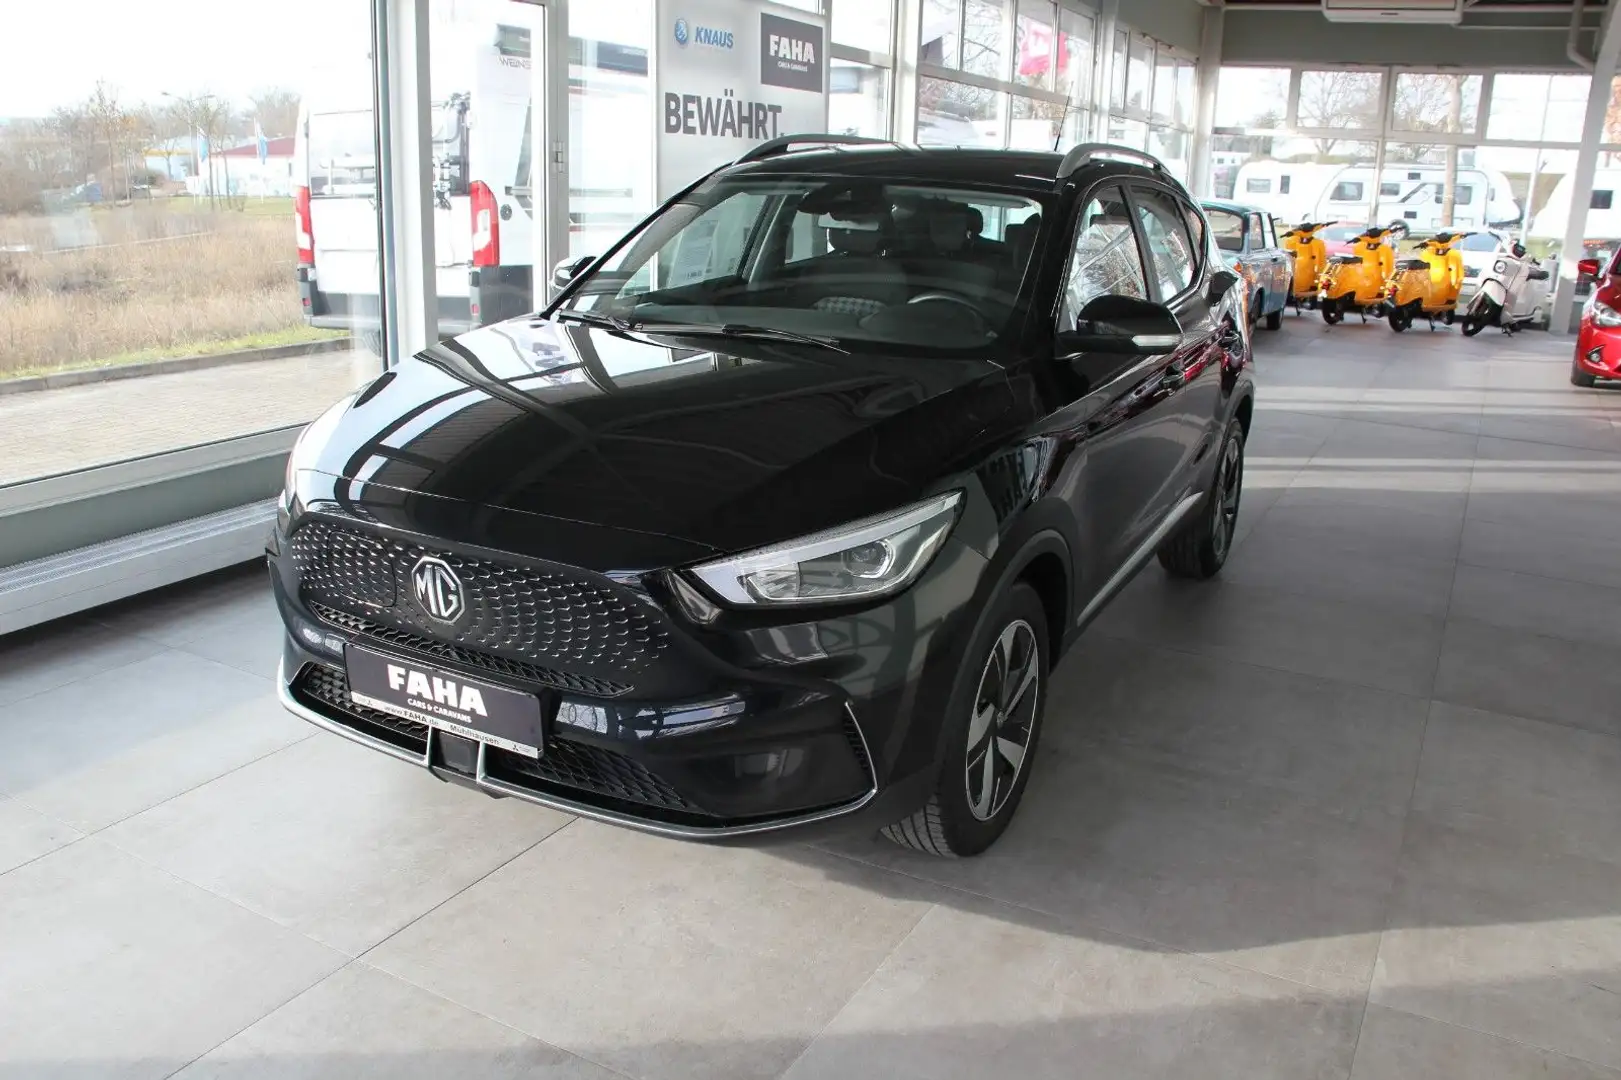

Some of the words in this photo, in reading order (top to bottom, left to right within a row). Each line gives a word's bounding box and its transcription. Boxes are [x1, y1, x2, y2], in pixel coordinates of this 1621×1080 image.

[695, 26, 734, 49] KNAUS
[769, 34, 815, 64] FAHA
[415, 564, 460, 617] MG
[387, 663, 488, 717] FAHA
